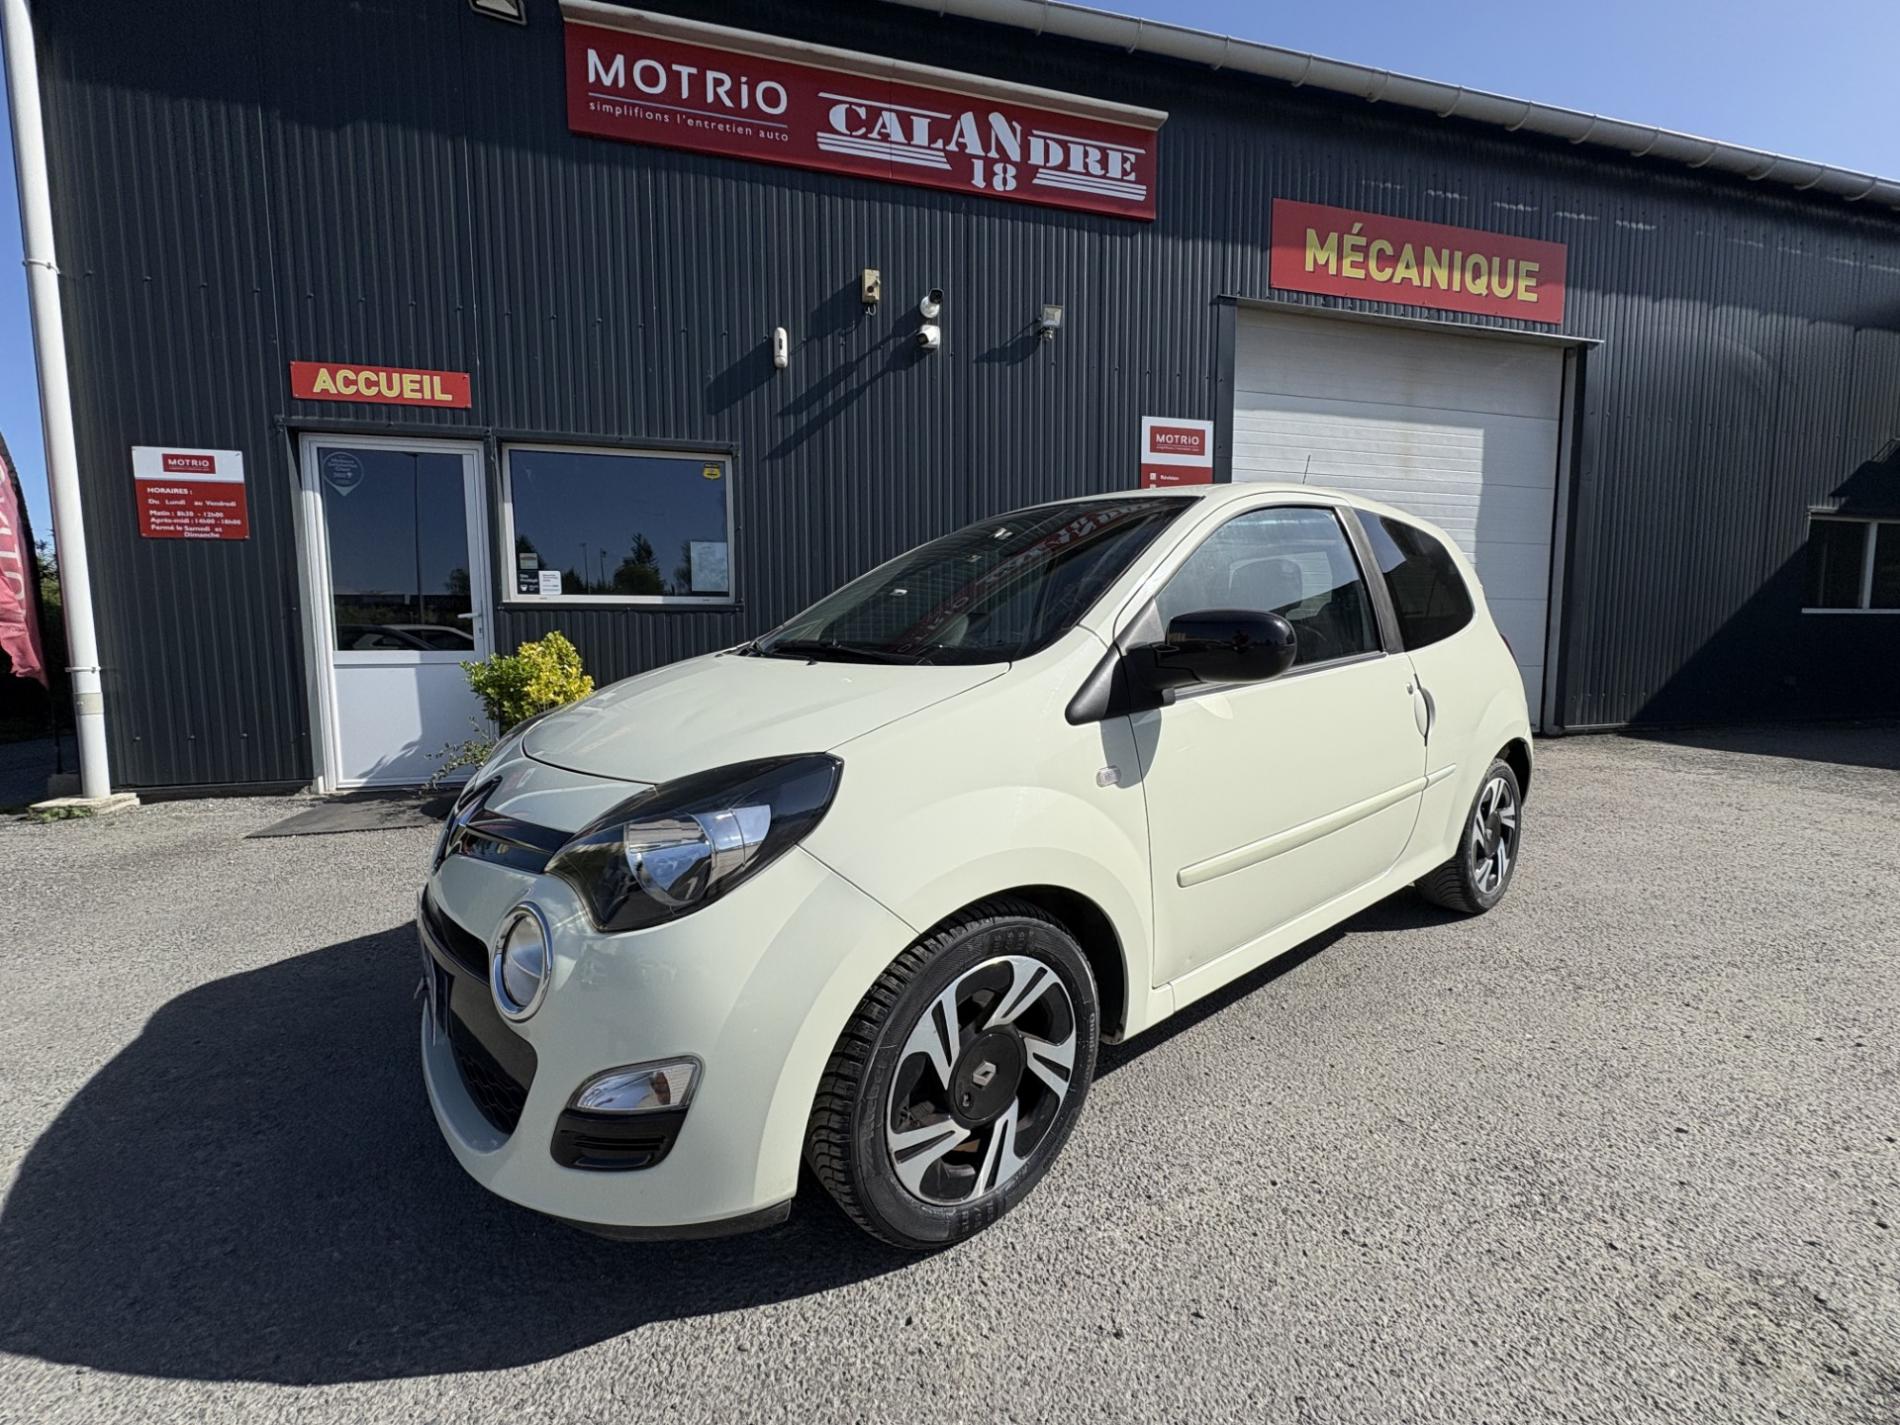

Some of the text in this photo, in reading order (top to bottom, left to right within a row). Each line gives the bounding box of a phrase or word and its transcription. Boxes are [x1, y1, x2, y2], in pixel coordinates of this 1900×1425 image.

[589, 101, 789, 142] simplifions l'entretien auto
[828, 104, 1137, 181] CALANDRE
[970, 158, 1017, 191] 18
[1304, 222, 1540, 303] MÉCANIQUE
[312, 368, 453, 401] ACCUEIL
